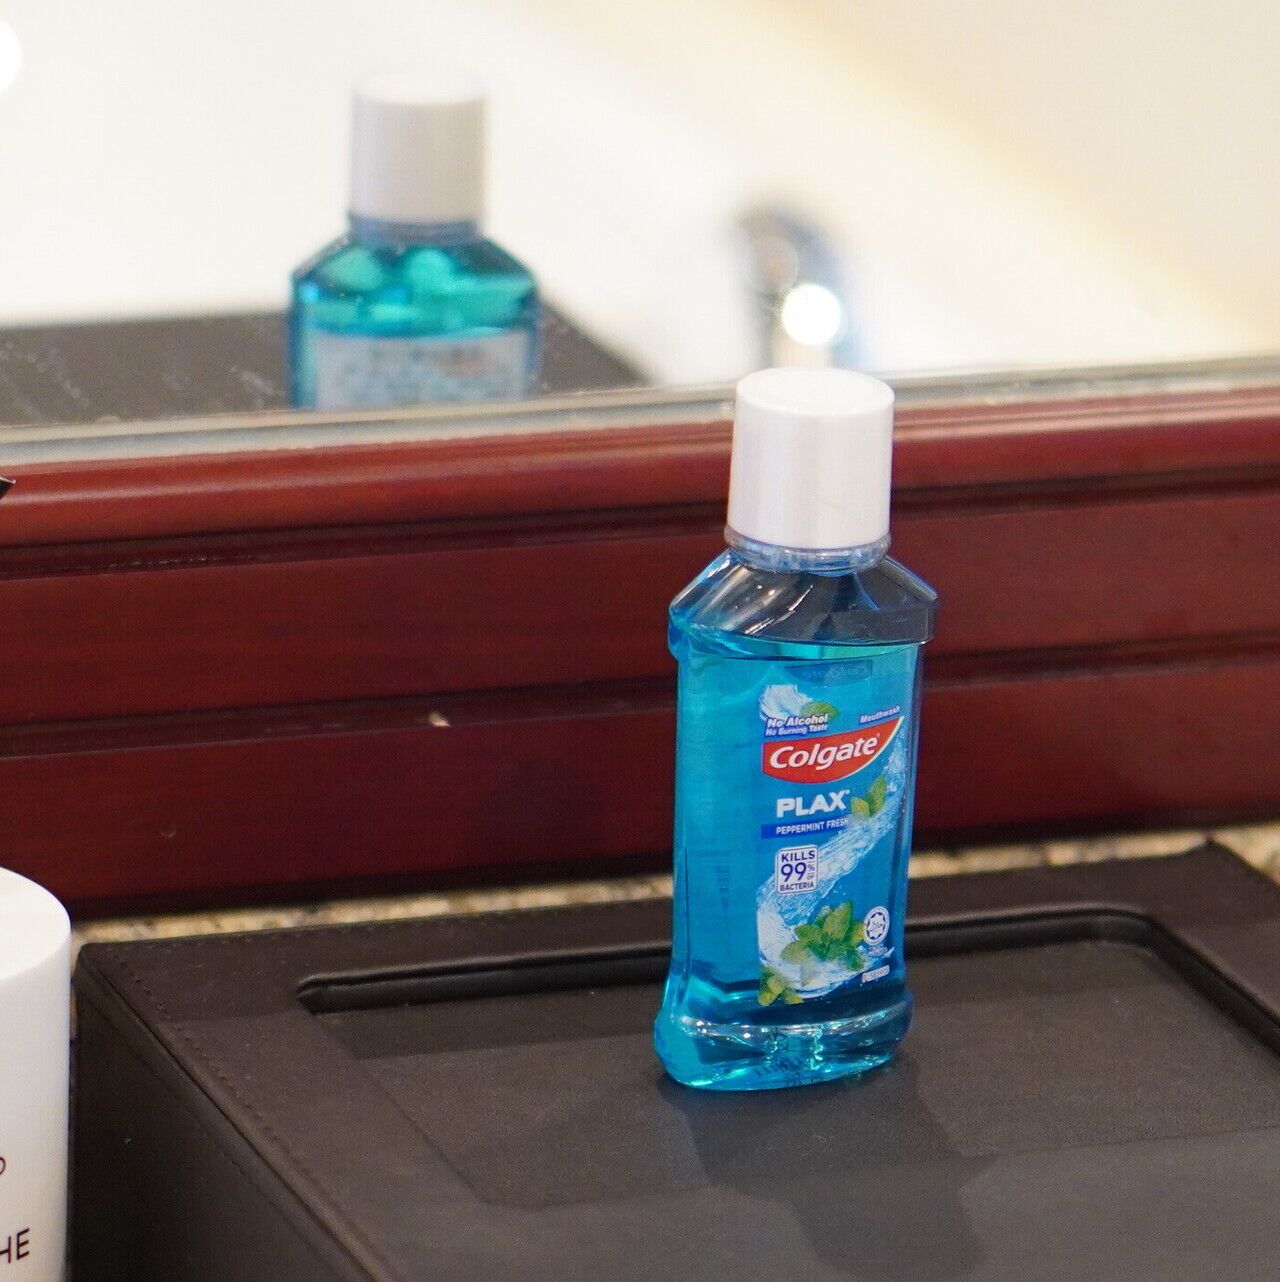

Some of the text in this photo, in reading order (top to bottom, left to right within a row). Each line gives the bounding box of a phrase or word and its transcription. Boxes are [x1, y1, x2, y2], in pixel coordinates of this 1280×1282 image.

[767, 713, 828, 728] No Alcohol
[769, 736, 878, 771] Colgate
[776, 790, 847, 818] PLAX
[776, 816, 849, 835] PEPPERMINT FRESH
[781, 850, 816, 863] KILLS
[779, 880, 815, 892] BACTERIA
